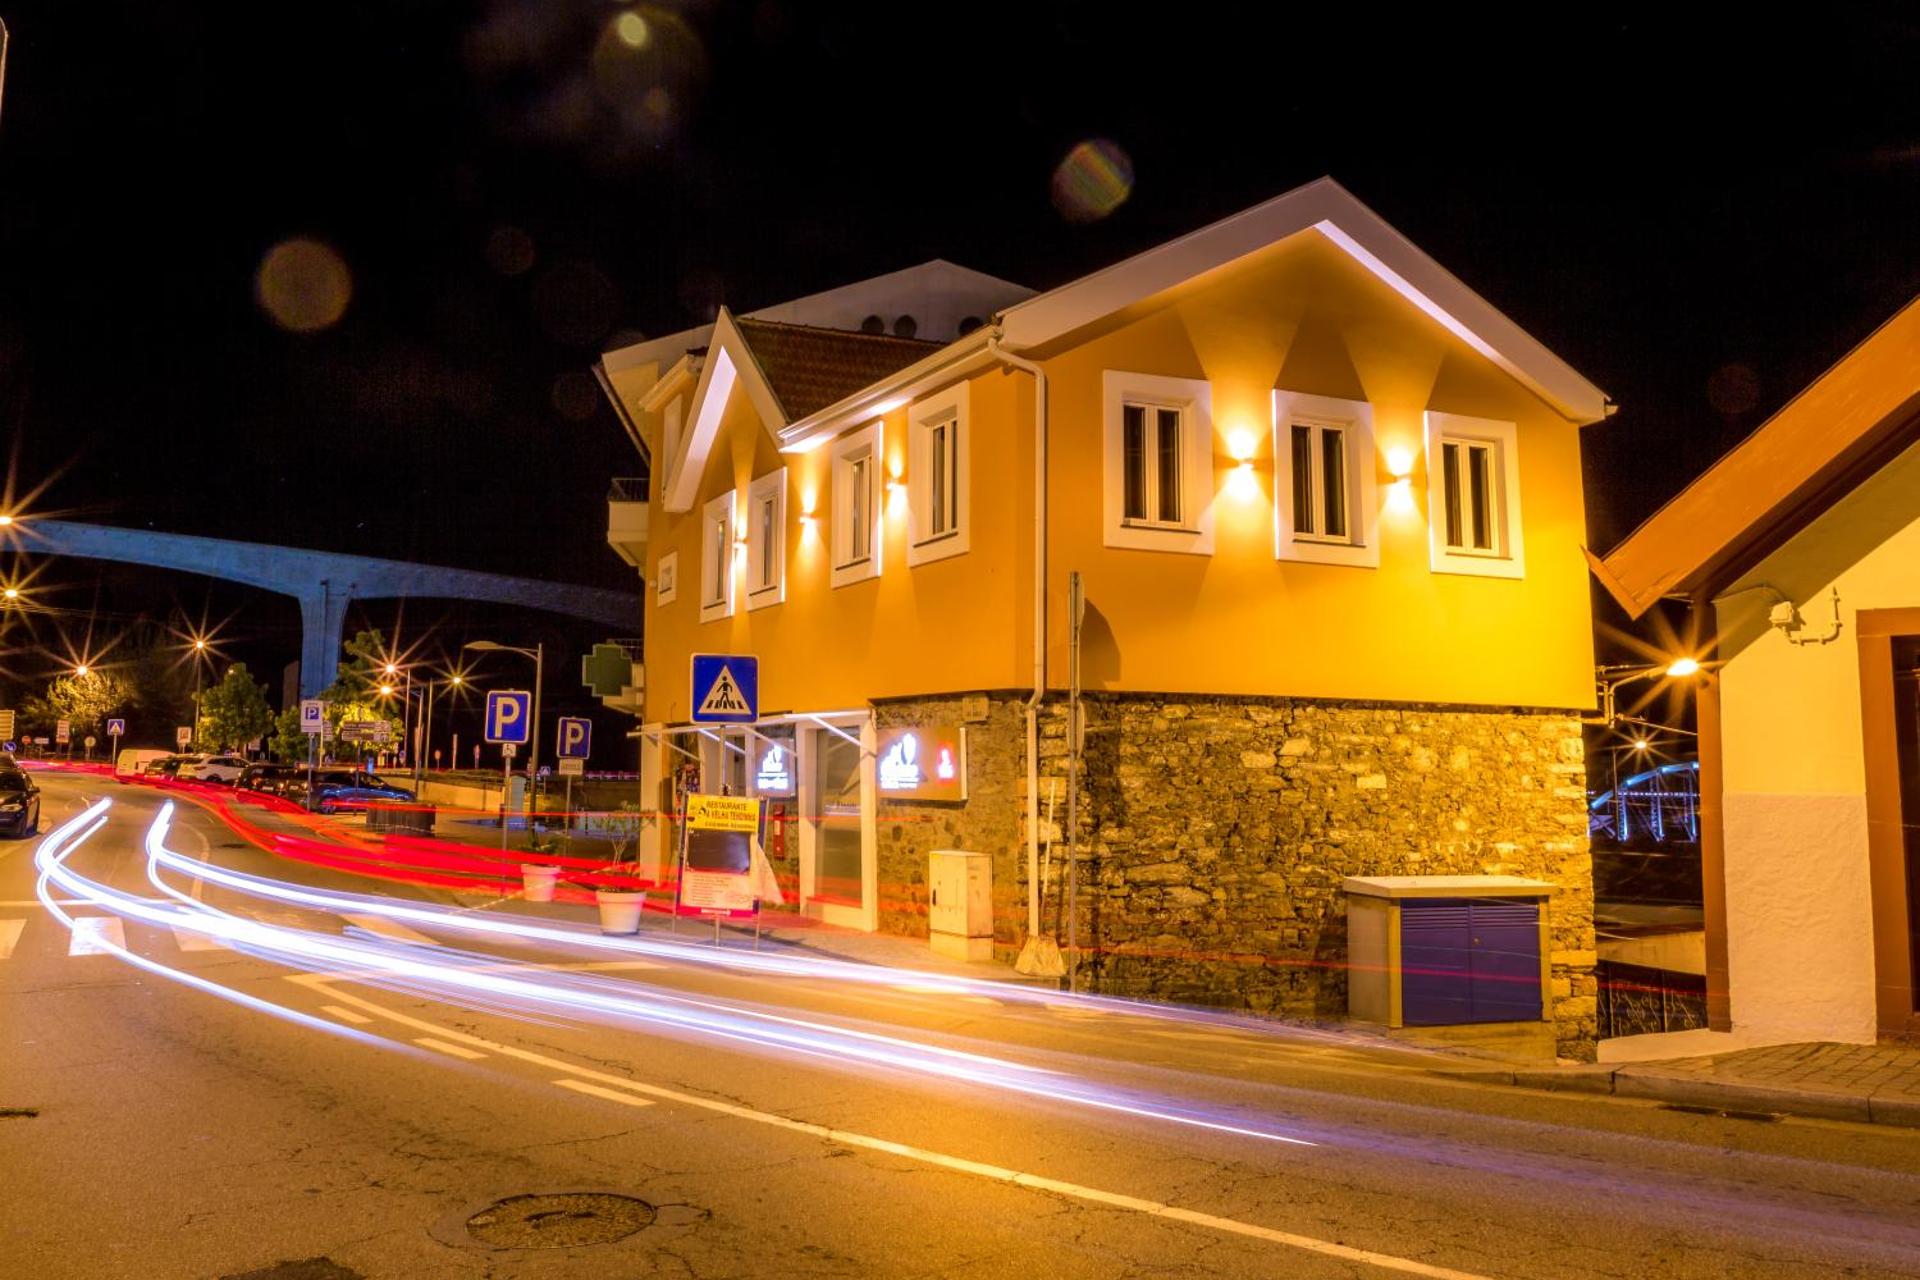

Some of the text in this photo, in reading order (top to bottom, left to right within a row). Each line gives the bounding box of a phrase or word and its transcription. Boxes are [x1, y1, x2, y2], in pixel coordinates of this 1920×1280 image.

[308, 708, 317, 720] P
[495, 697, 520, 738] P
[565, 722, 584, 755] P
[706, 800, 747, 811] RESTAURANTE
